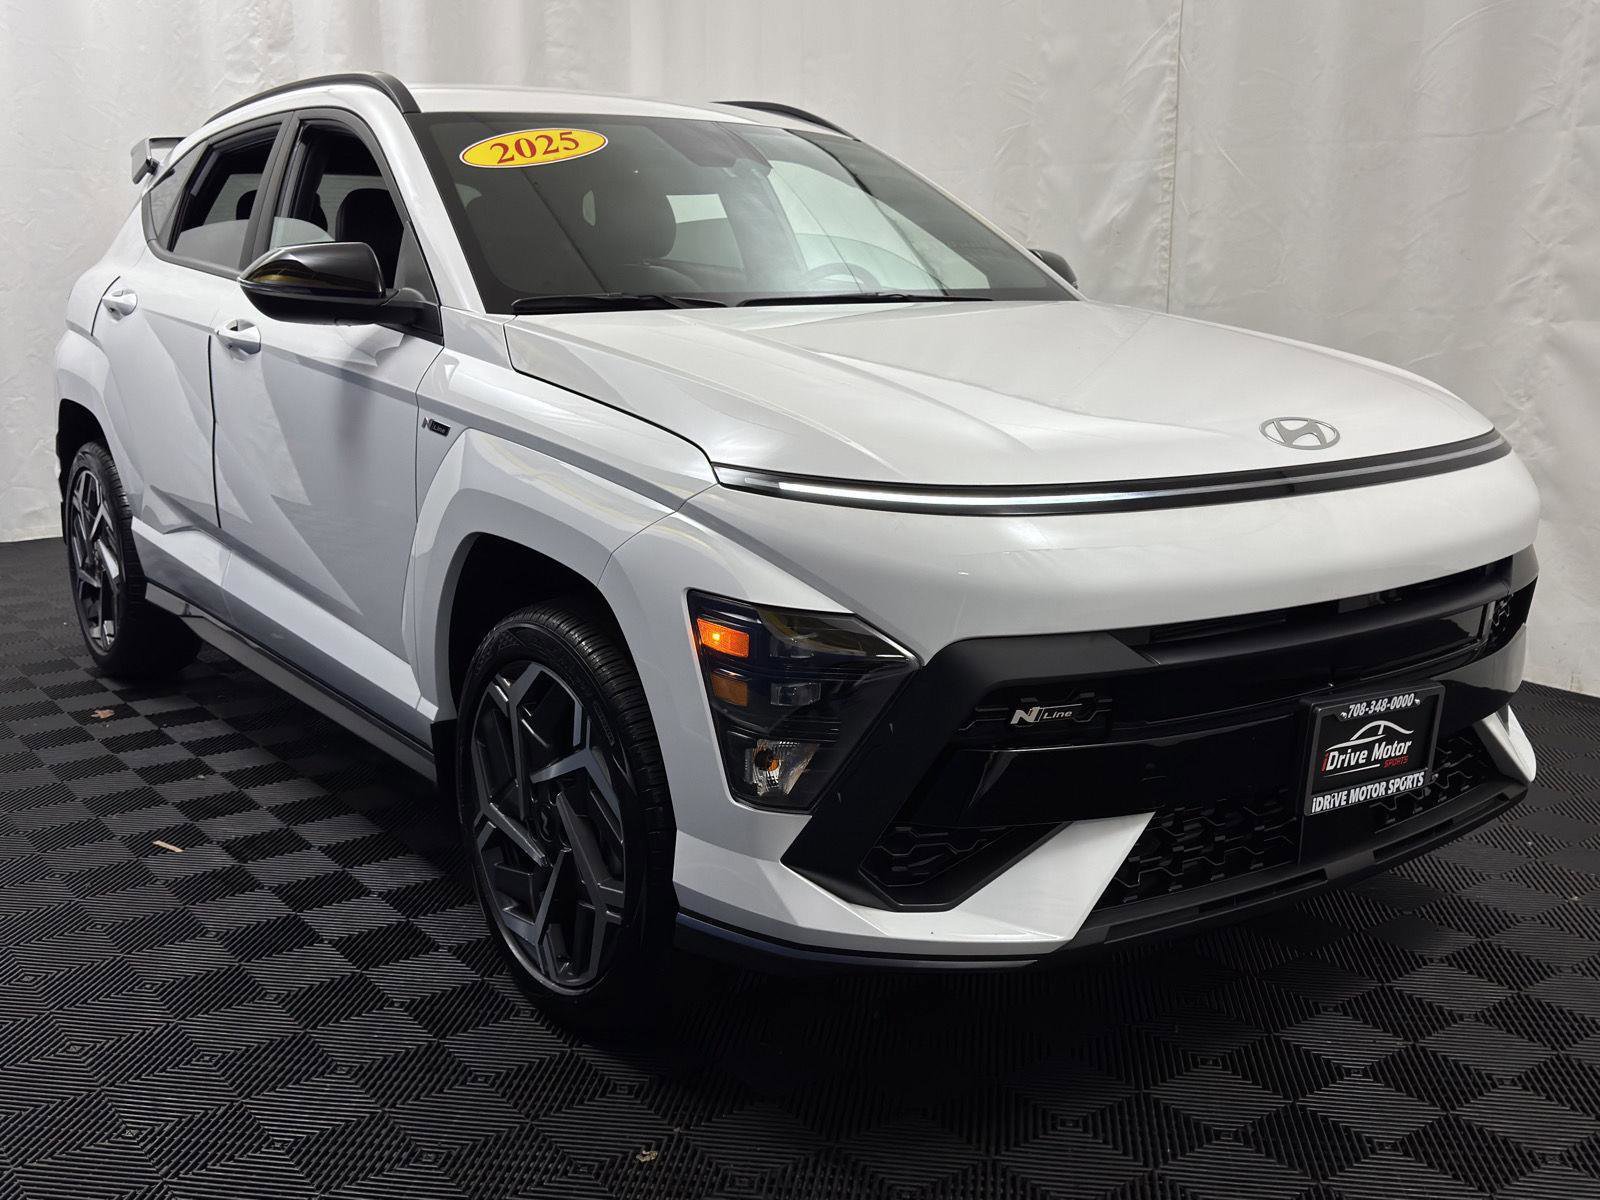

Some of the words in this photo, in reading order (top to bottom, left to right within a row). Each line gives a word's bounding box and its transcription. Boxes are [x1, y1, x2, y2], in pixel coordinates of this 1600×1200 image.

[490, 131, 580, 165] 2025
[1010, 706, 1040, 725] N
[1347, 693, 1415, 719] 708-348-0000
[1321, 748, 1368, 773] iDrive
[1371, 740, 1412, 762] Motor
[1384, 755, 1409, 769] SPORTS
[1348, 781, 1387, 804] MOTOR
[1387, 771, 1425, 794] SPORTS
